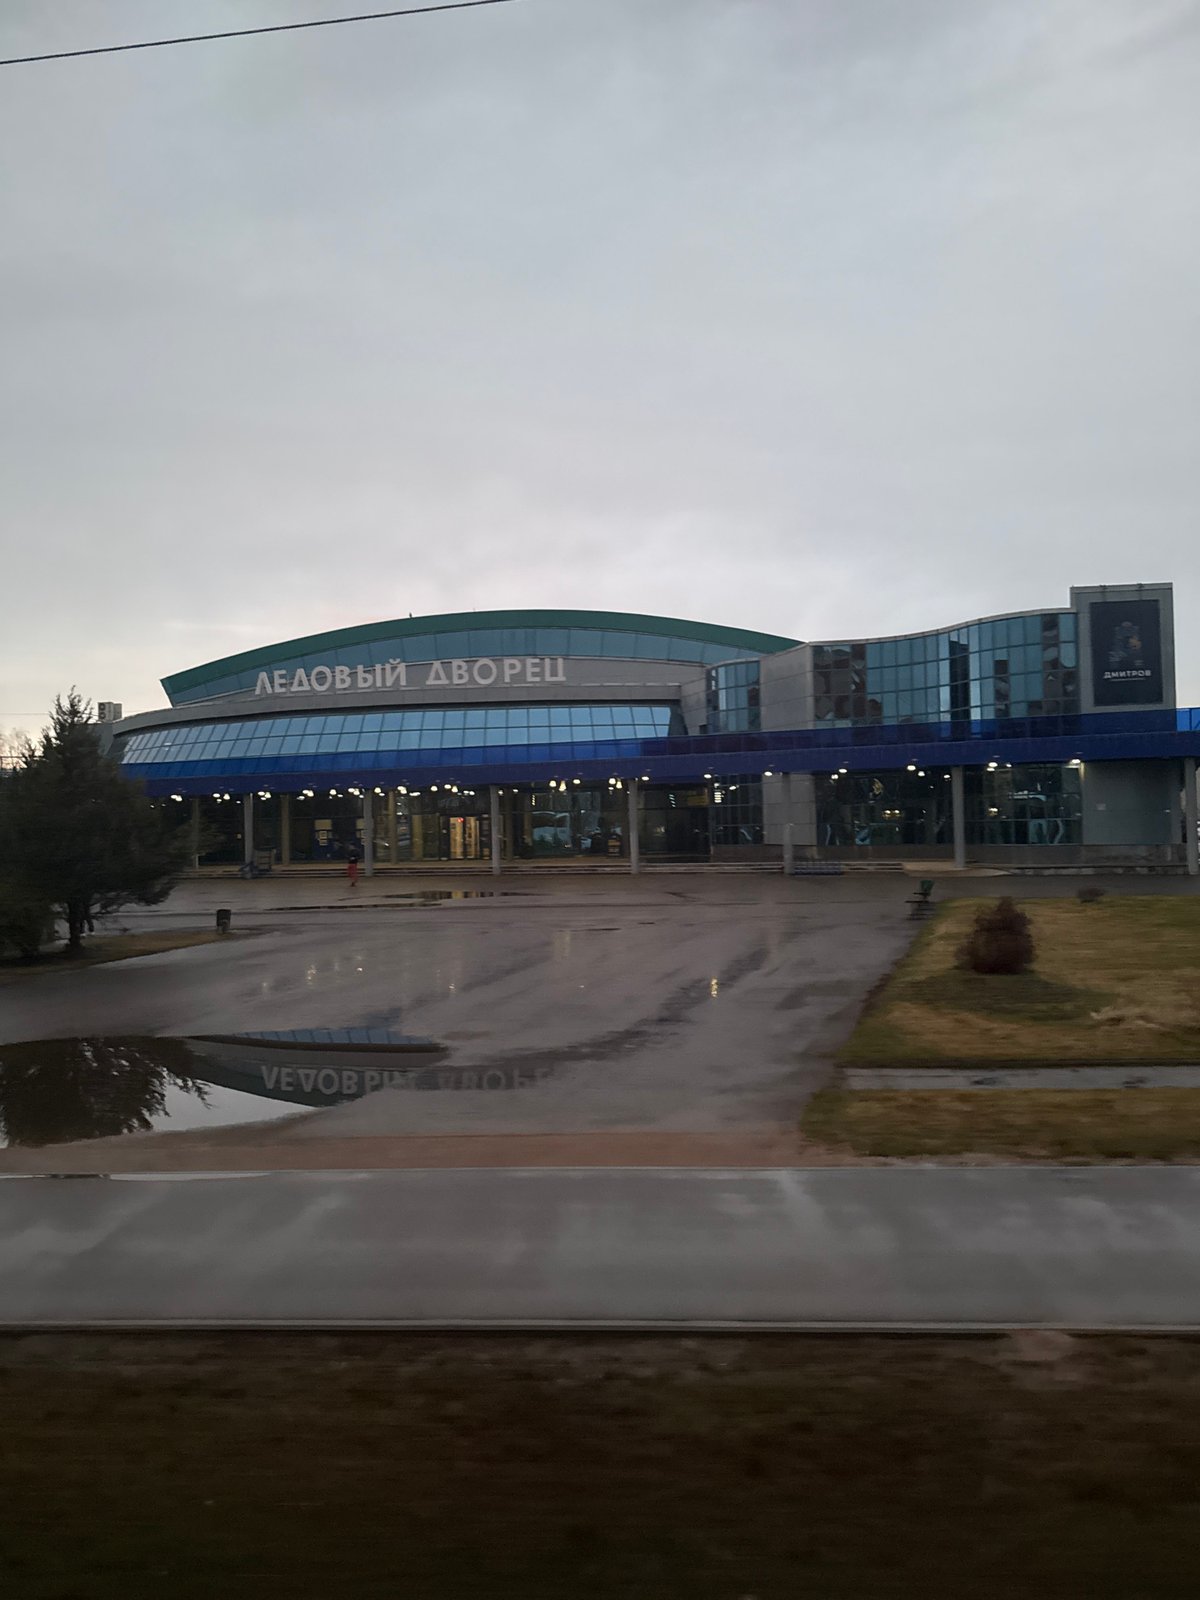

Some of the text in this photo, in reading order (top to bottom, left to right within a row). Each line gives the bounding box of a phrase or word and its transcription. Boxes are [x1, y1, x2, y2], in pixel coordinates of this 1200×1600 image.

[255, 657, 566, 695] ЛЕДОВЫЙ ДВОРЕЦ
[1104, 670, 1152, 679] ДМИТРОВ
